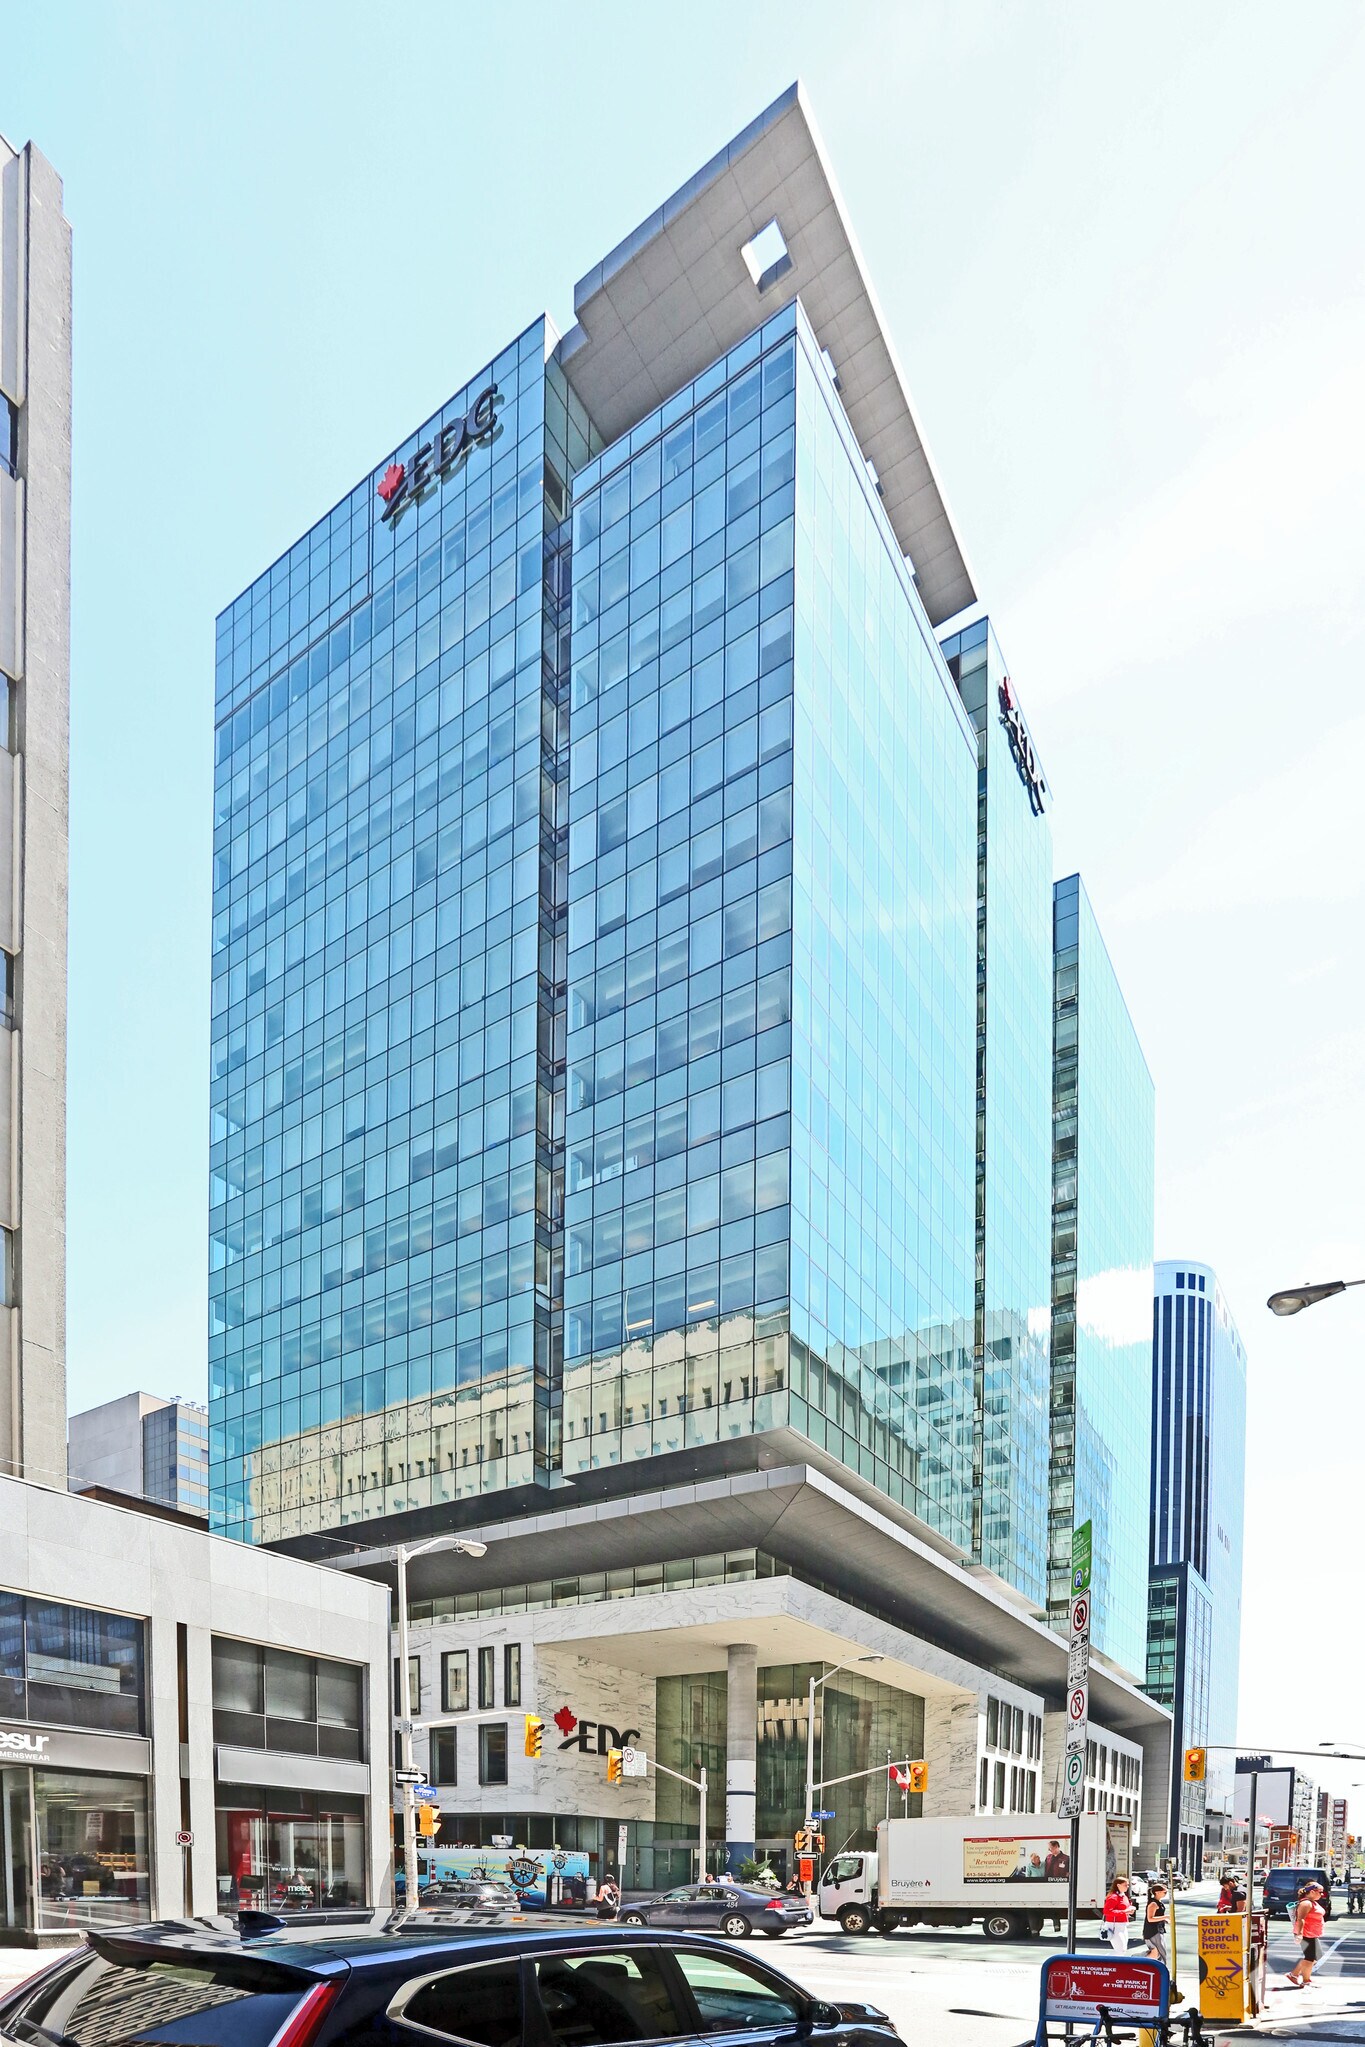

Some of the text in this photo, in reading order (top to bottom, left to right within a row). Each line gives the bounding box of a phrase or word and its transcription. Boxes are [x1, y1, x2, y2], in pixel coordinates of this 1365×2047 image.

[381, 382, 499, 523] EDC
[558, 1720, 640, 1757] EDC
[975, 1858, 1008, 1866] Rewarding
[891, 1880, 923, 1888] Bruyère
[1202, 1934, 1239, 1942] search
